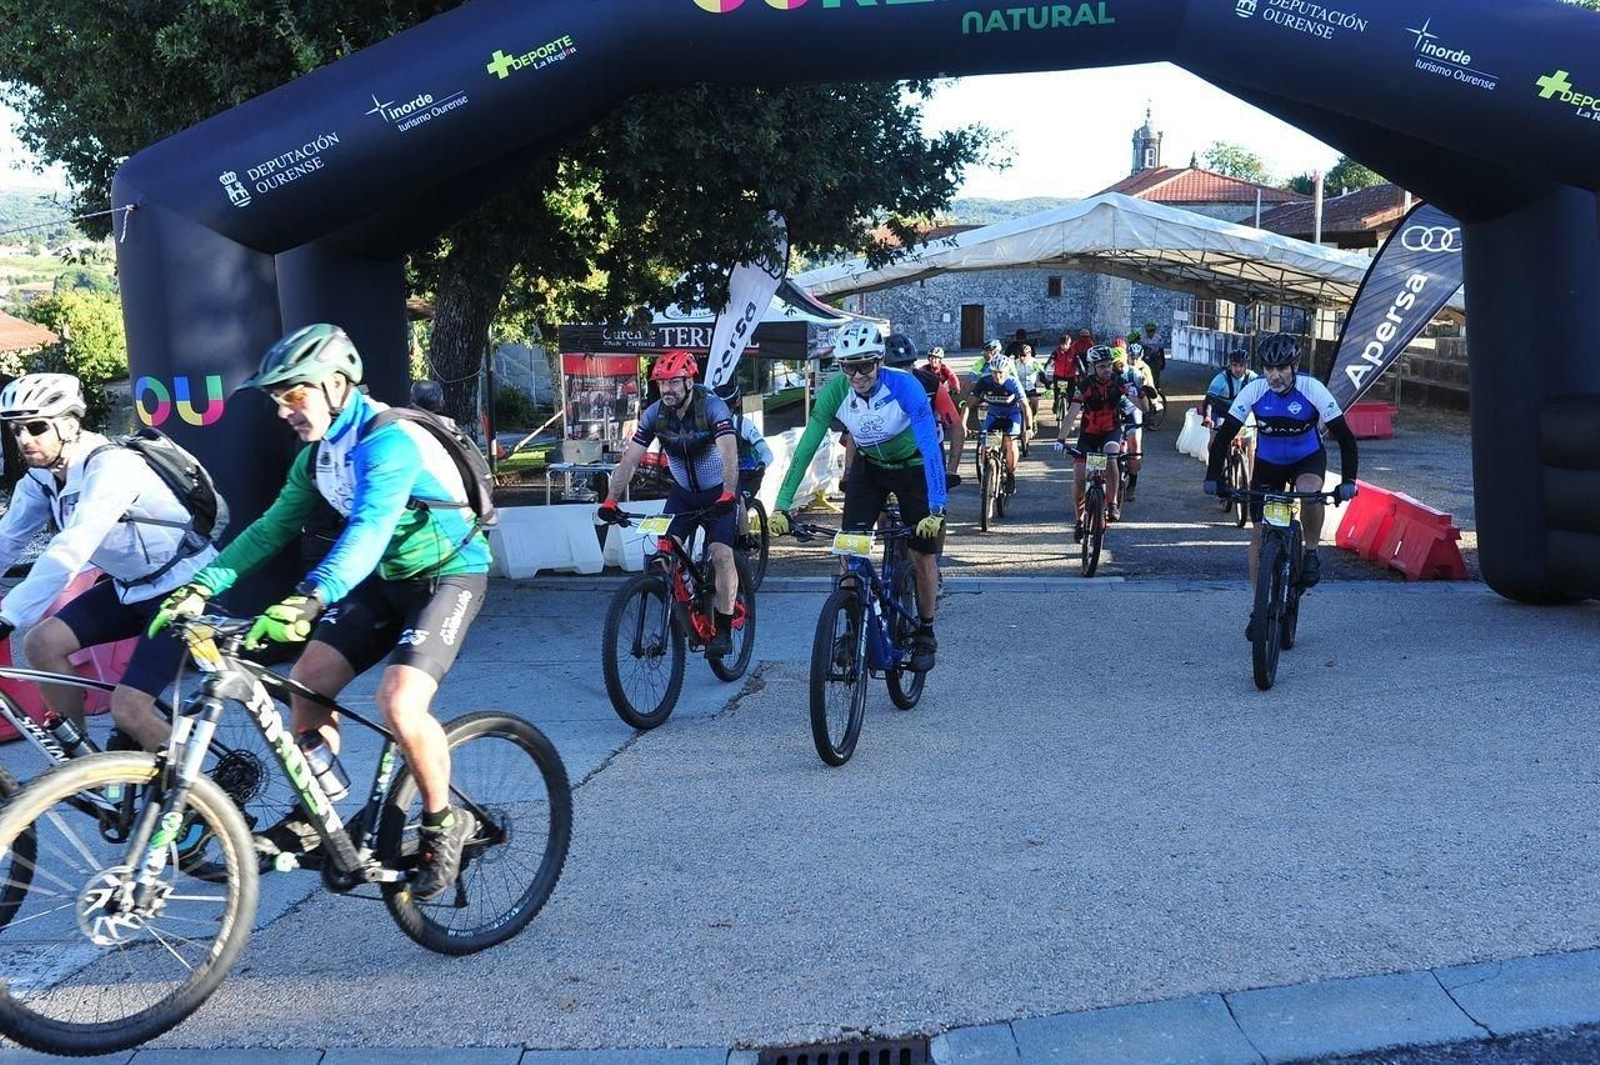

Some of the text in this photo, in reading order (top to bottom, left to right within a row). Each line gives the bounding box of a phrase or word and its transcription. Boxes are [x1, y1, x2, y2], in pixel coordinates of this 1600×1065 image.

[1262, 7, 1335, 39] OURENSE
[511, 34, 574, 70] DEPORTE
[533, 60, 547, 70] La
[1421, 39, 1471, 65] inorde
[1415, 58, 1496, 91] turismo Ourense
[388, 94, 433, 120] inorde
[397, 95, 469, 132] turismo Ourense
[1576, 107, 1591, 118] La
[246, 131, 340, 181] DEPUTACIÓN
[255, 156, 325, 194] OURENSE
[1344, 273, 1428, 391] Apersa
[135, 374, 225, 427] OU
